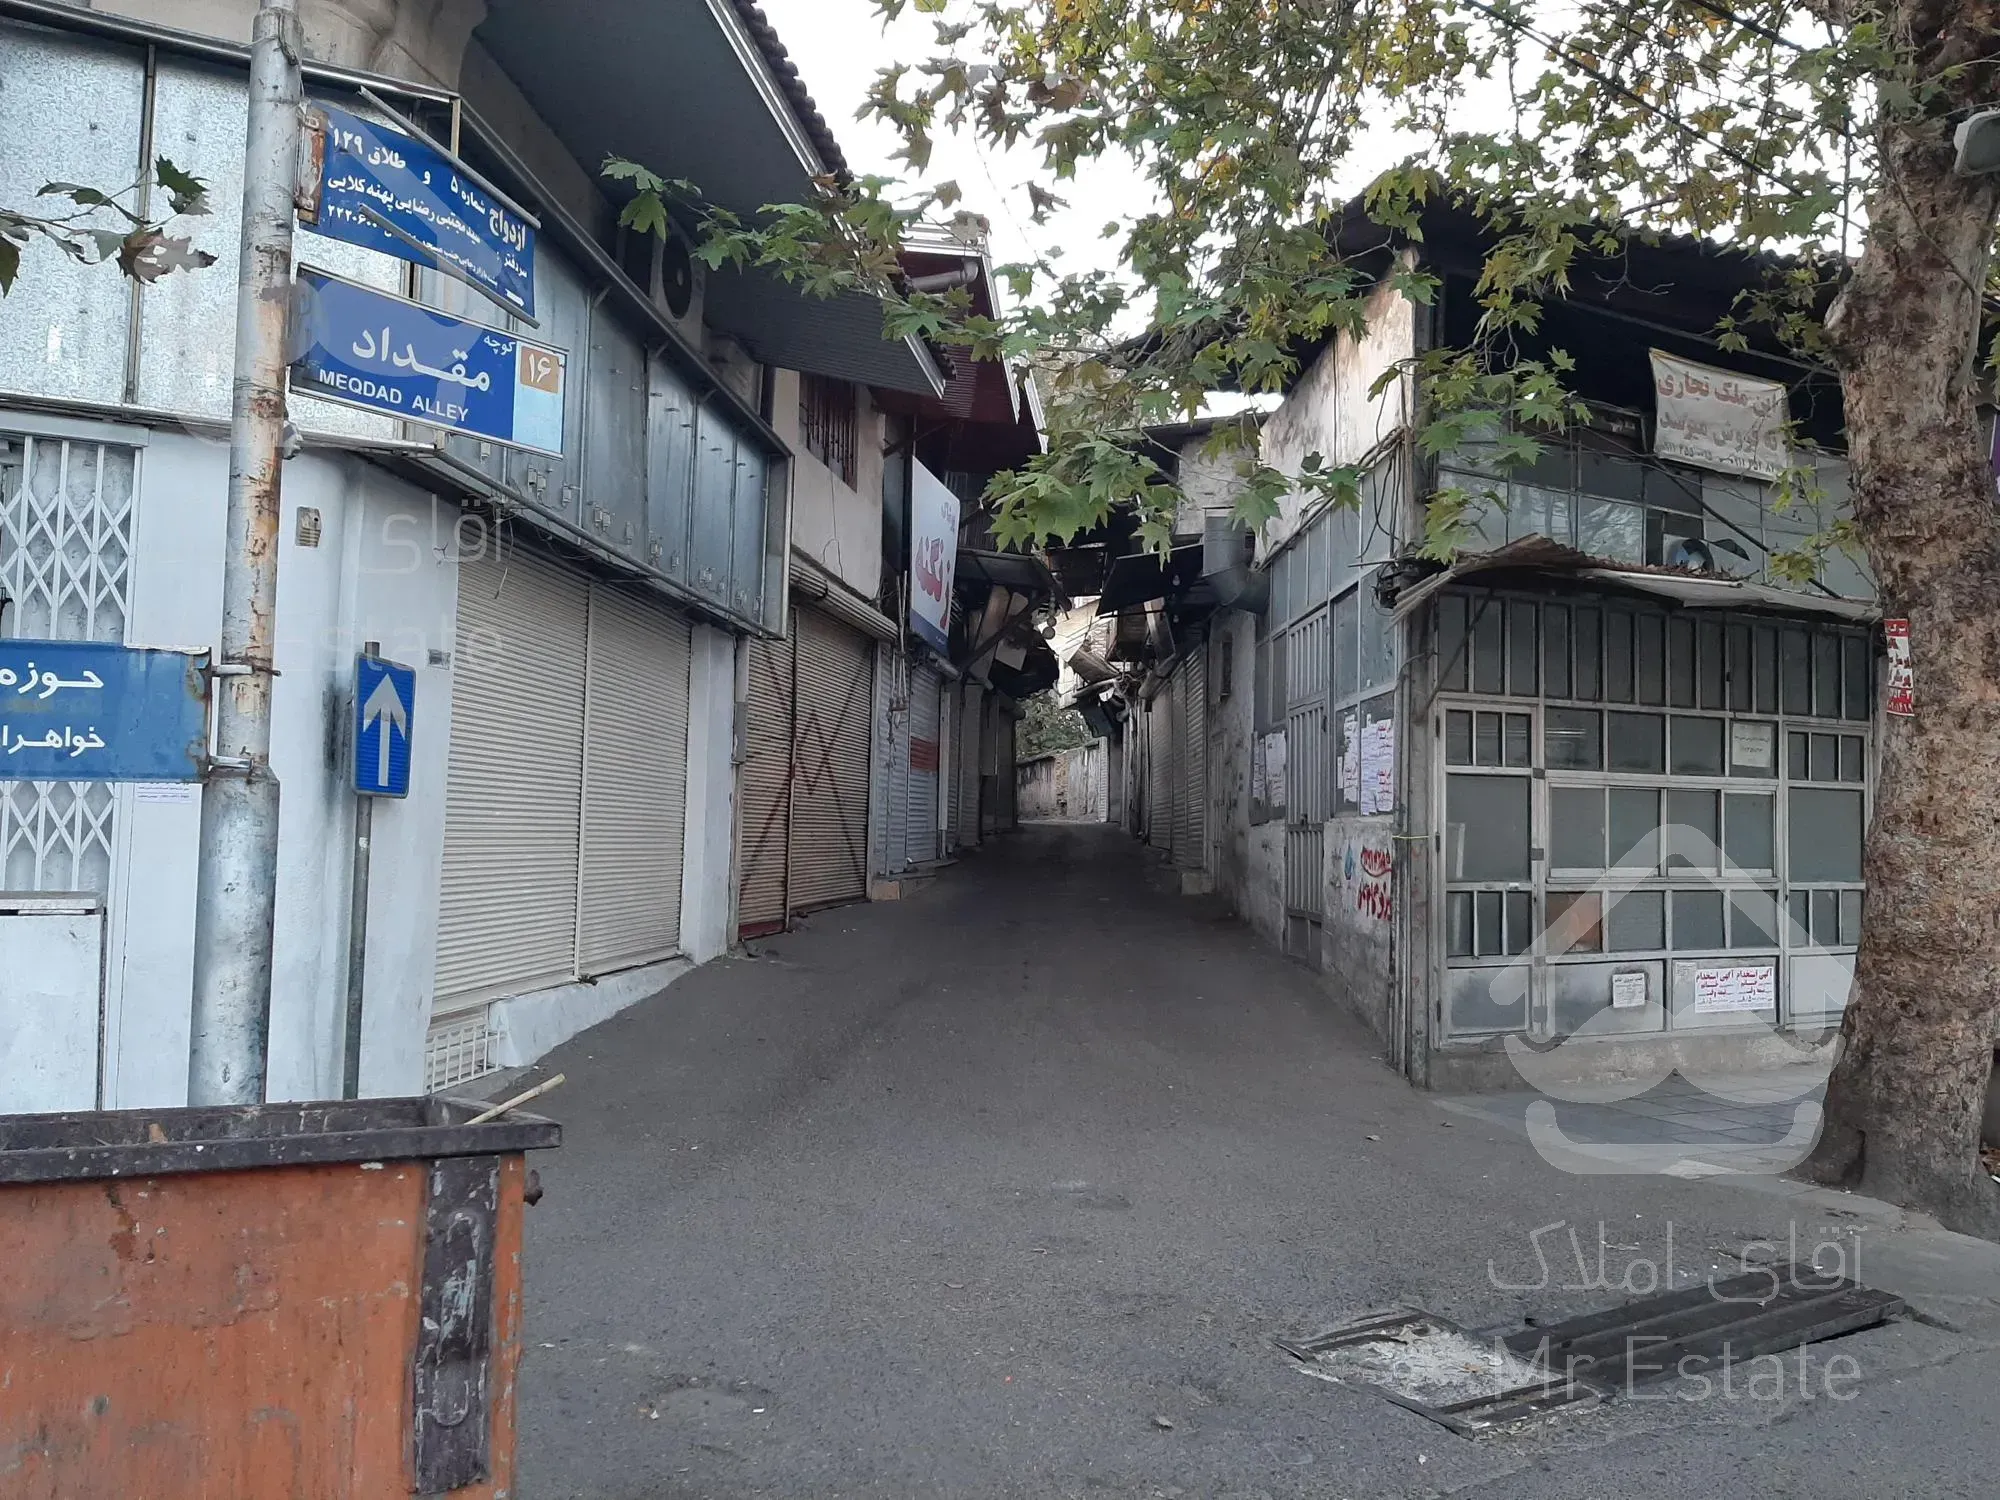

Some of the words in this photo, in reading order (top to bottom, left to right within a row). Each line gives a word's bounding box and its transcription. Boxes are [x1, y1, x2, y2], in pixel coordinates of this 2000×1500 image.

[368, 146, 406, 169] طلاق
[422, 170, 431, 185] و
[450, 175, 459, 194] ۵
[394, 197, 435, 222] رضایی
[461, 190, 486, 216] شماره
[436, 211, 466, 234] مجتبی
[489, 208, 526, 252] ازدواج
[466, 226, 481, 246] سید
[483, 334, 516, 356] کوچه
[352, 326, 490, 392] مقداد
[528, 352, 552, 384] ۱۶
[318, 368, 403, 404] MEQDAD
[411, 394, 469, 422] ALLEY
[1657, 371, 1710, 400] تجاری
[1714, 379, 1748, 405] ملک
[0, 662, 104, 699] حوزه
[1696, 971, 1719, 983] استخدام
[1736, 969, 1758, 980] استخدام
